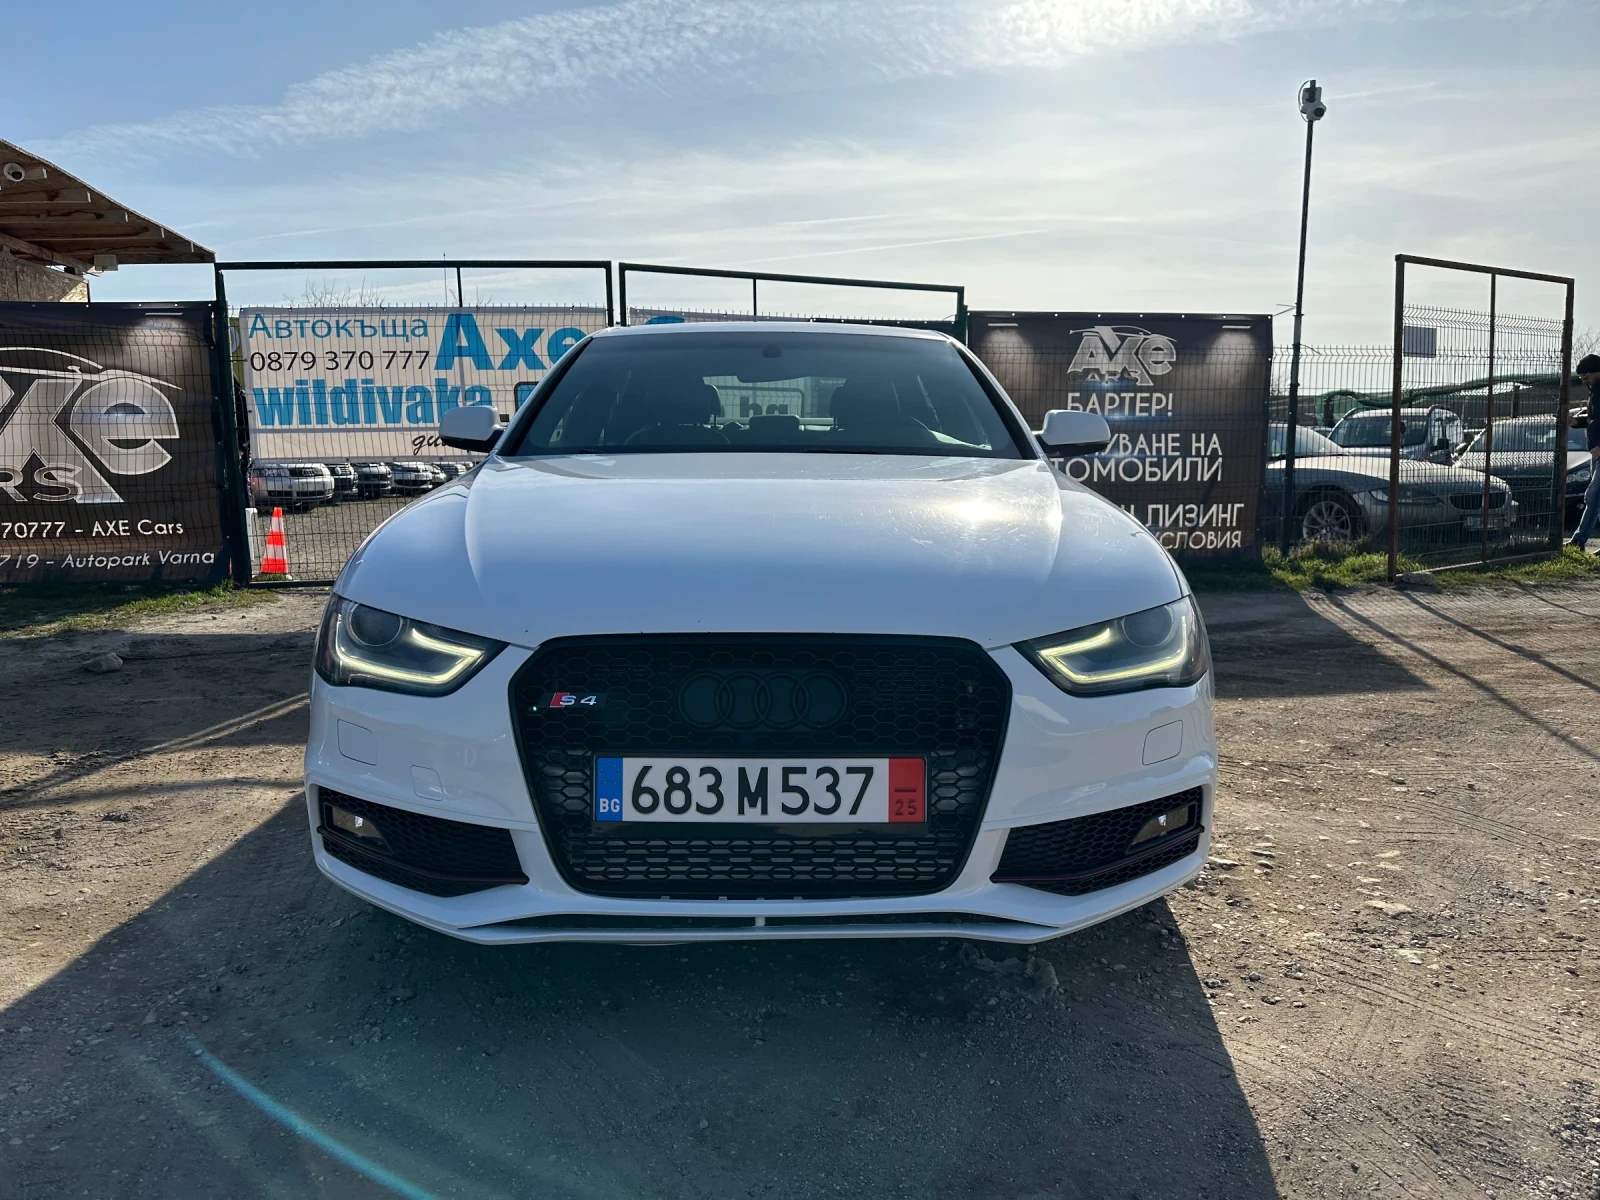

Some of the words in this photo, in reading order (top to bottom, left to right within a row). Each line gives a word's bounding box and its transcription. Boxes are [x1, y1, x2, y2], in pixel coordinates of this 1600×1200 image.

[248, 313, 428, 341] Автокъща
[250, 351, 316, 371] 0879
[325, 351, 374, 370] 370
[382, 350, 430, 370] 777
[1067, 393, 1173, 416] БАРТЕР!
[1192, 433, 1223, 456] НА
[1145, 503, 1245, 528] ЛИЗИНГ
[92, 520, 131, 537] AXE
[137, 519, 184, 535] Cars
[1155, 531, 1242, 549] СЛОВИЯ
[61, 552, 150, 570] Autopark
[158, 550, 215, 565] Varna
[599, 798, 621, 814] BG
[894, 800, 918, 816] 25
